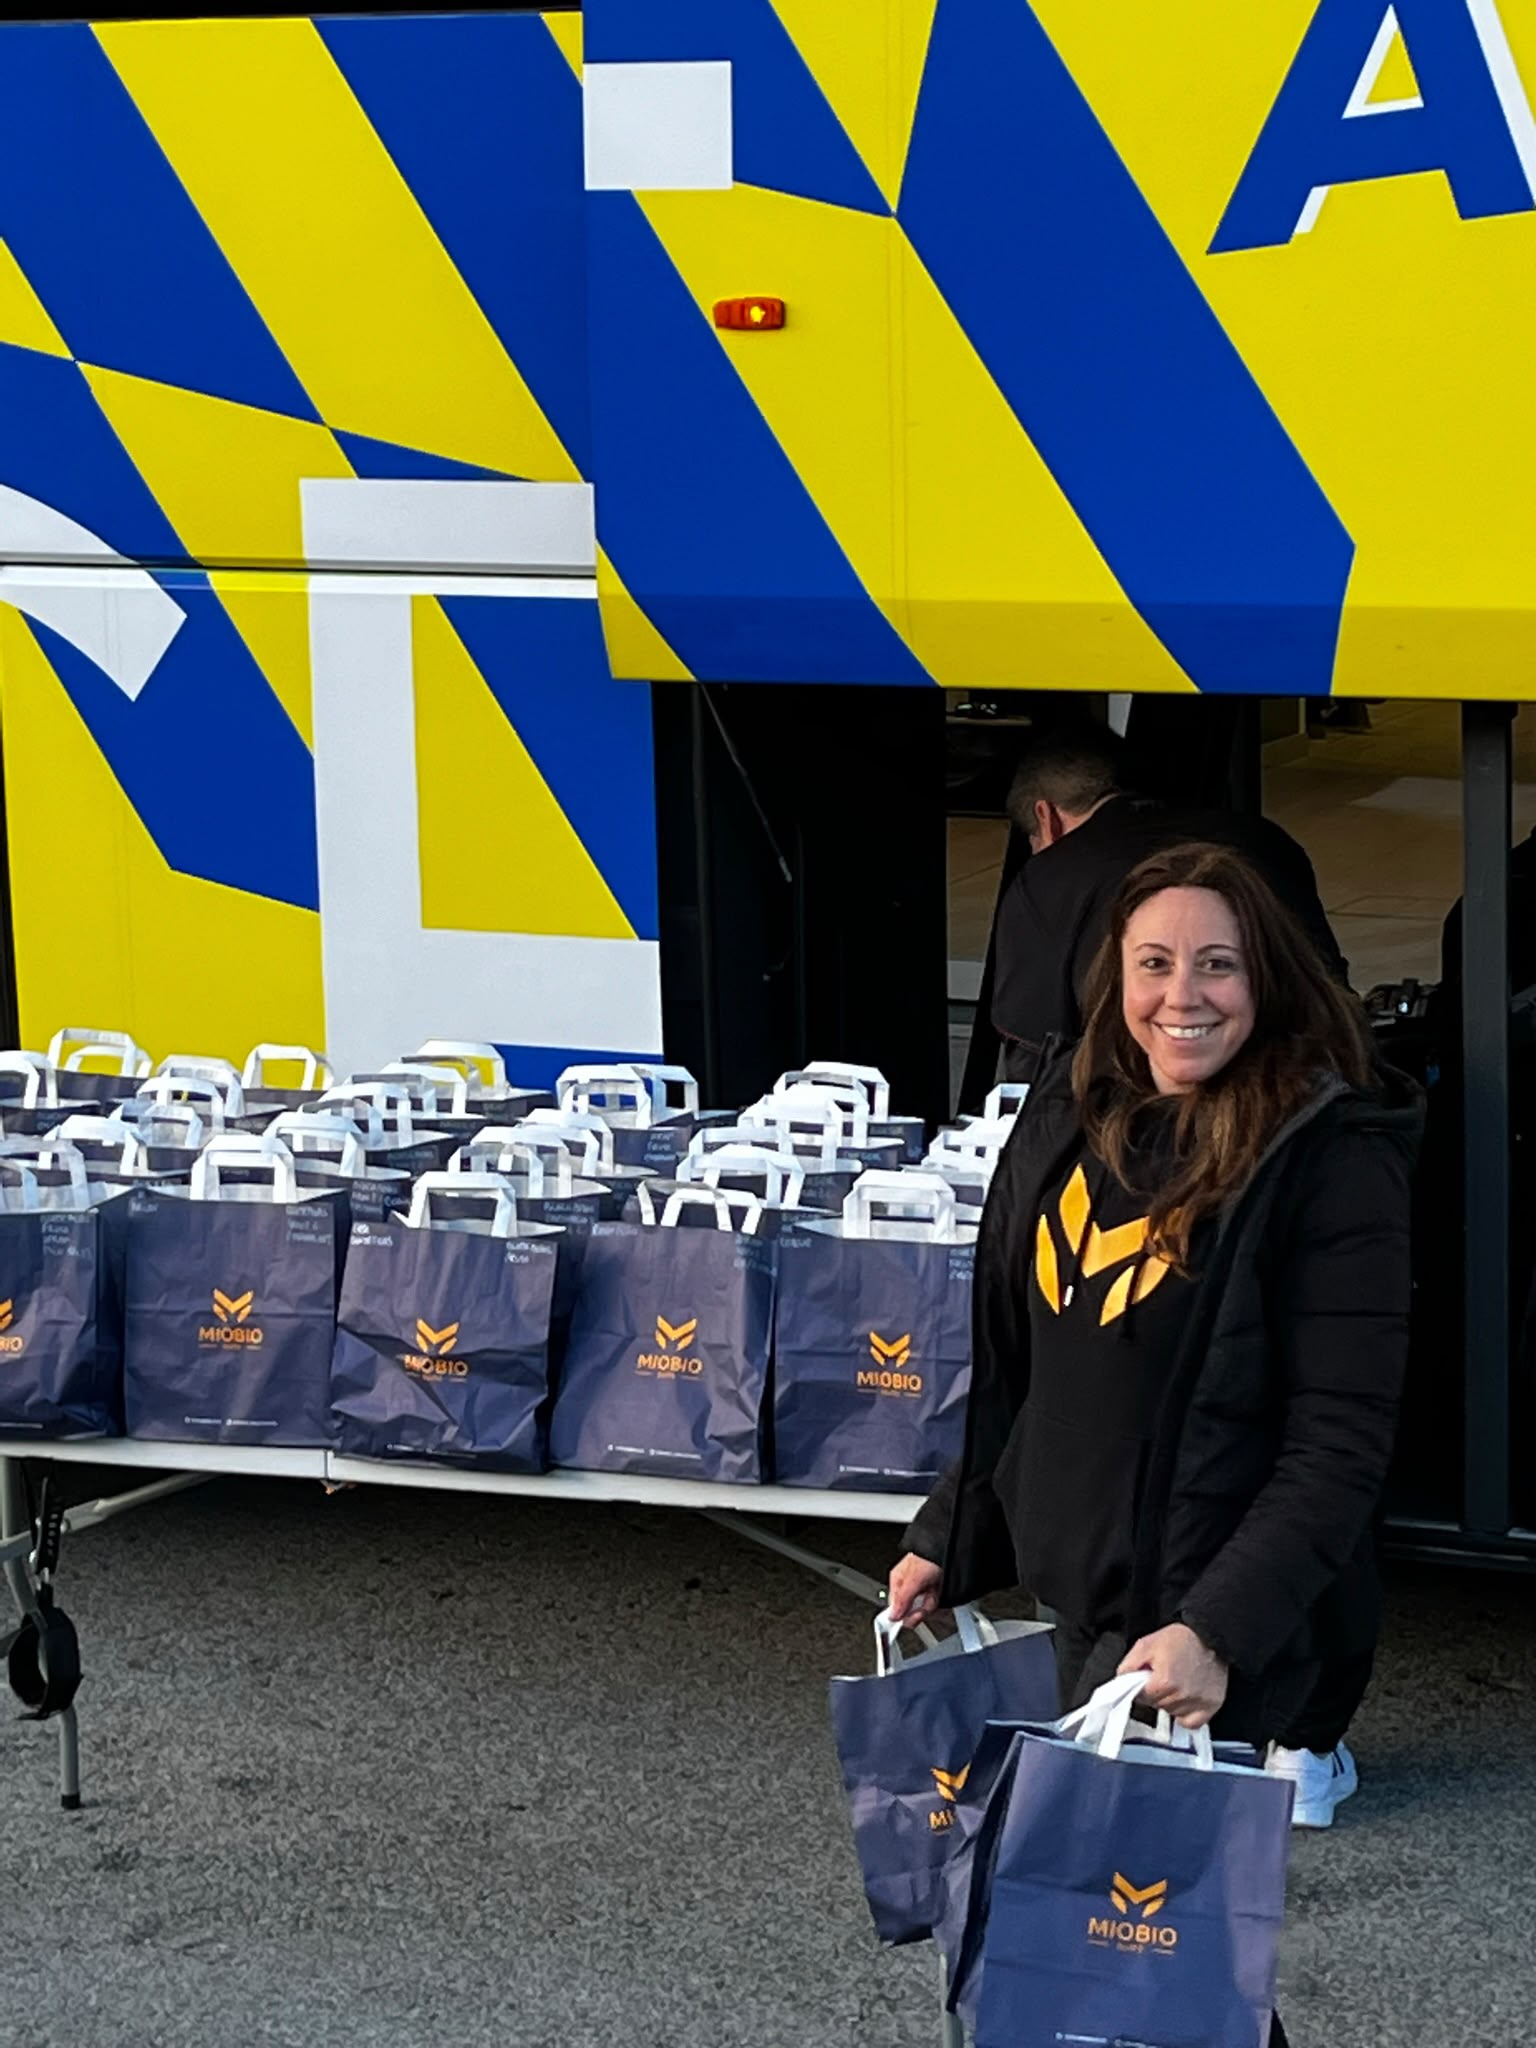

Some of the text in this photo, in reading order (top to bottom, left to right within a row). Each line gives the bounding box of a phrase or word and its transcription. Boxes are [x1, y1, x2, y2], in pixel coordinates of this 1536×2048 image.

[198, 1326, 263, 1345] MIOBIO
[404, 1354, 469, 1377] MIOBIO
[636, 1354, 703, 1375] MIOBIO
[856, 1371, 922, 1391] MIOBIO
[1087, 1917, 1178, 1947] MIOBIO
